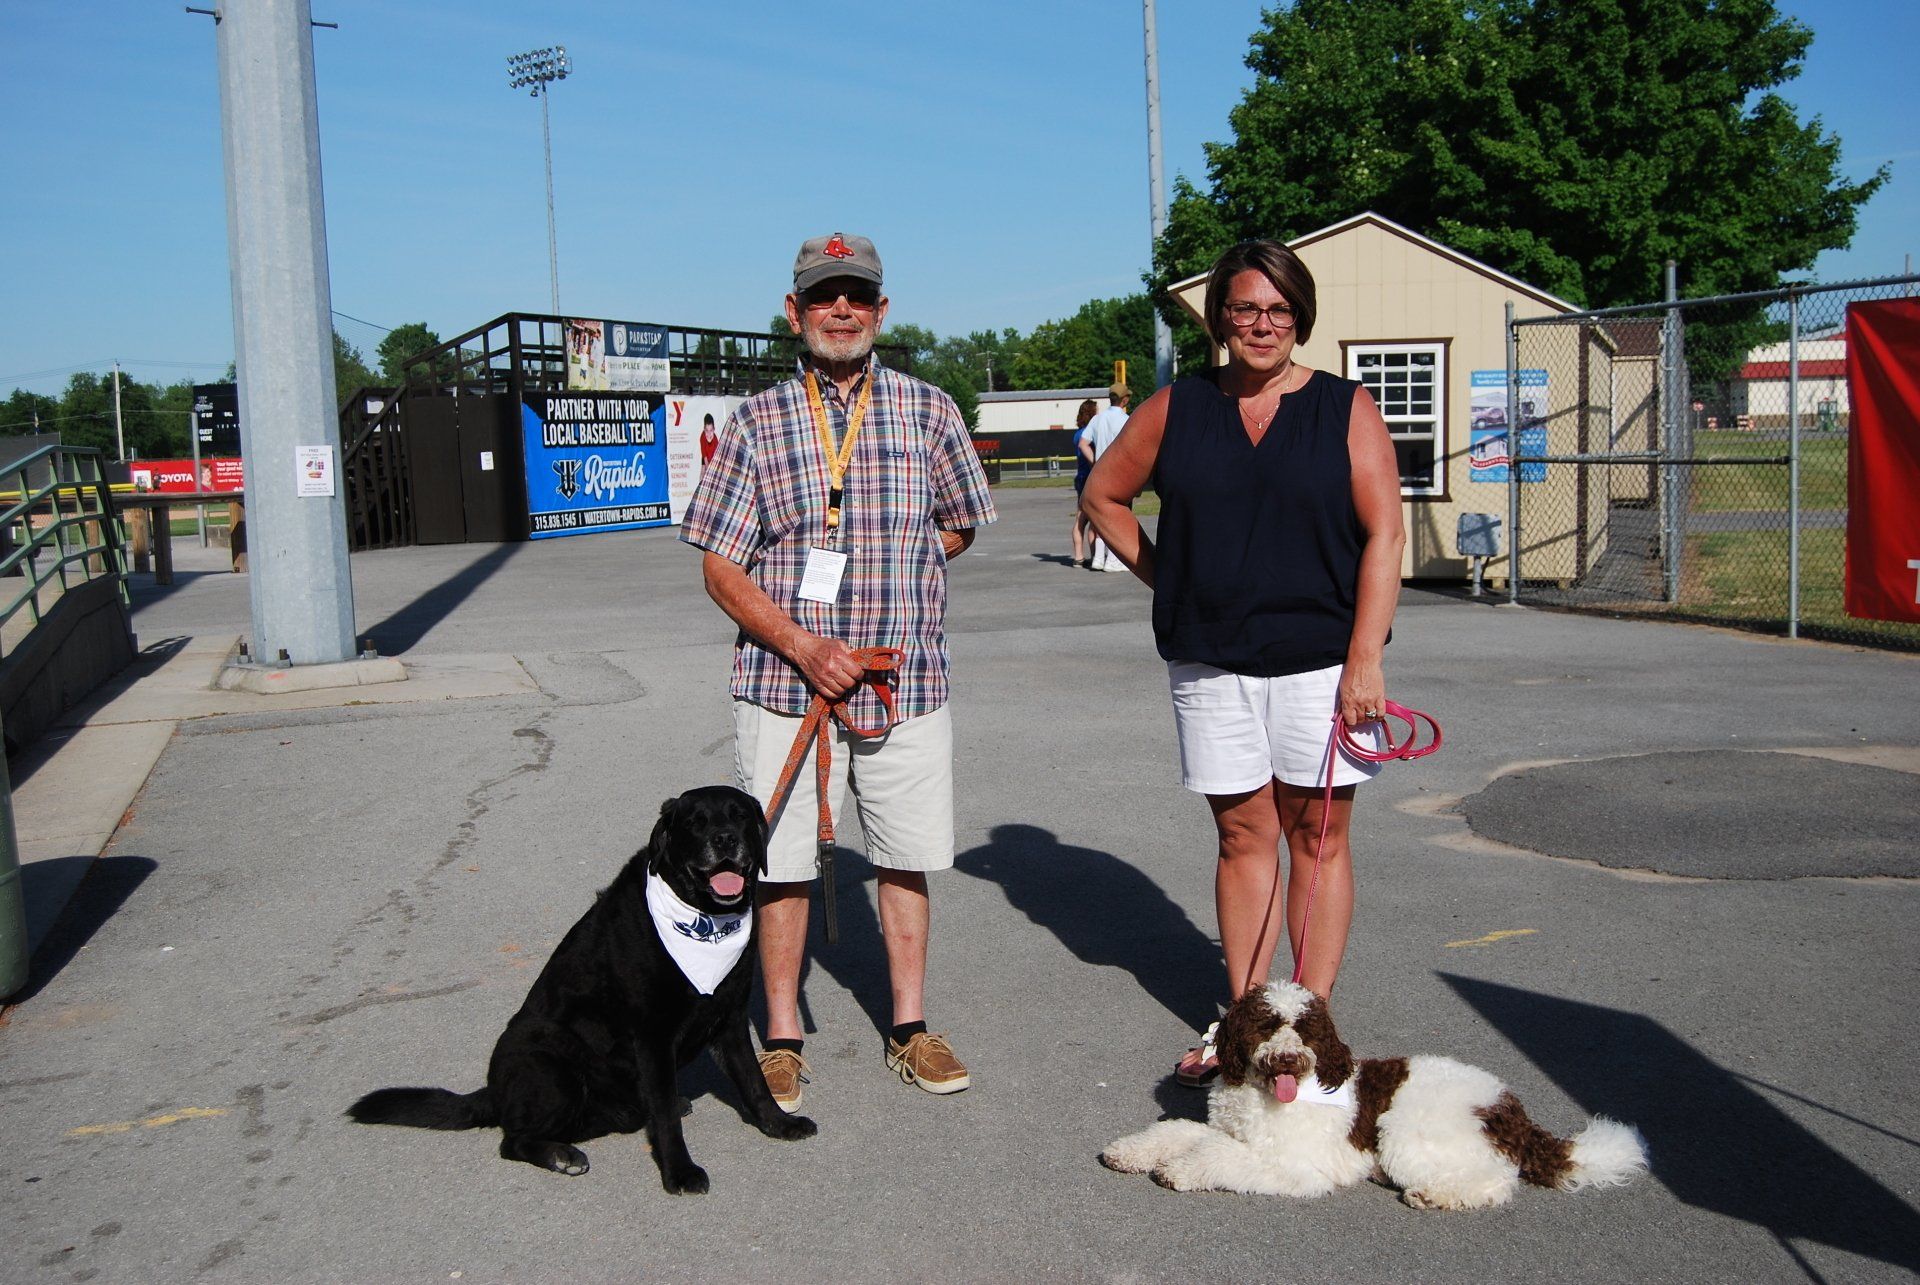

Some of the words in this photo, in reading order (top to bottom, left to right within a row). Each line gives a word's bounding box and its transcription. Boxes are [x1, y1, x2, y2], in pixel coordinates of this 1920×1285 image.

[547, 399, 595, 420] PARTNER
[597, 399, 621, 420] WITH
[623, 400, 650, 420] YOUR
[543, 423, 578, 446] LOCAL
[579, 422, 627, 444] BASEBALL
[628, 422, 655, 443] TEAM
[160, 473, 194, 483] OYOTA
[584, 451, 647, 501] Rapids
[534, 512, 577, 530] 315.836.1545
[584, 506, 657, 525] WATERTOWN-RAPIDS.COM
